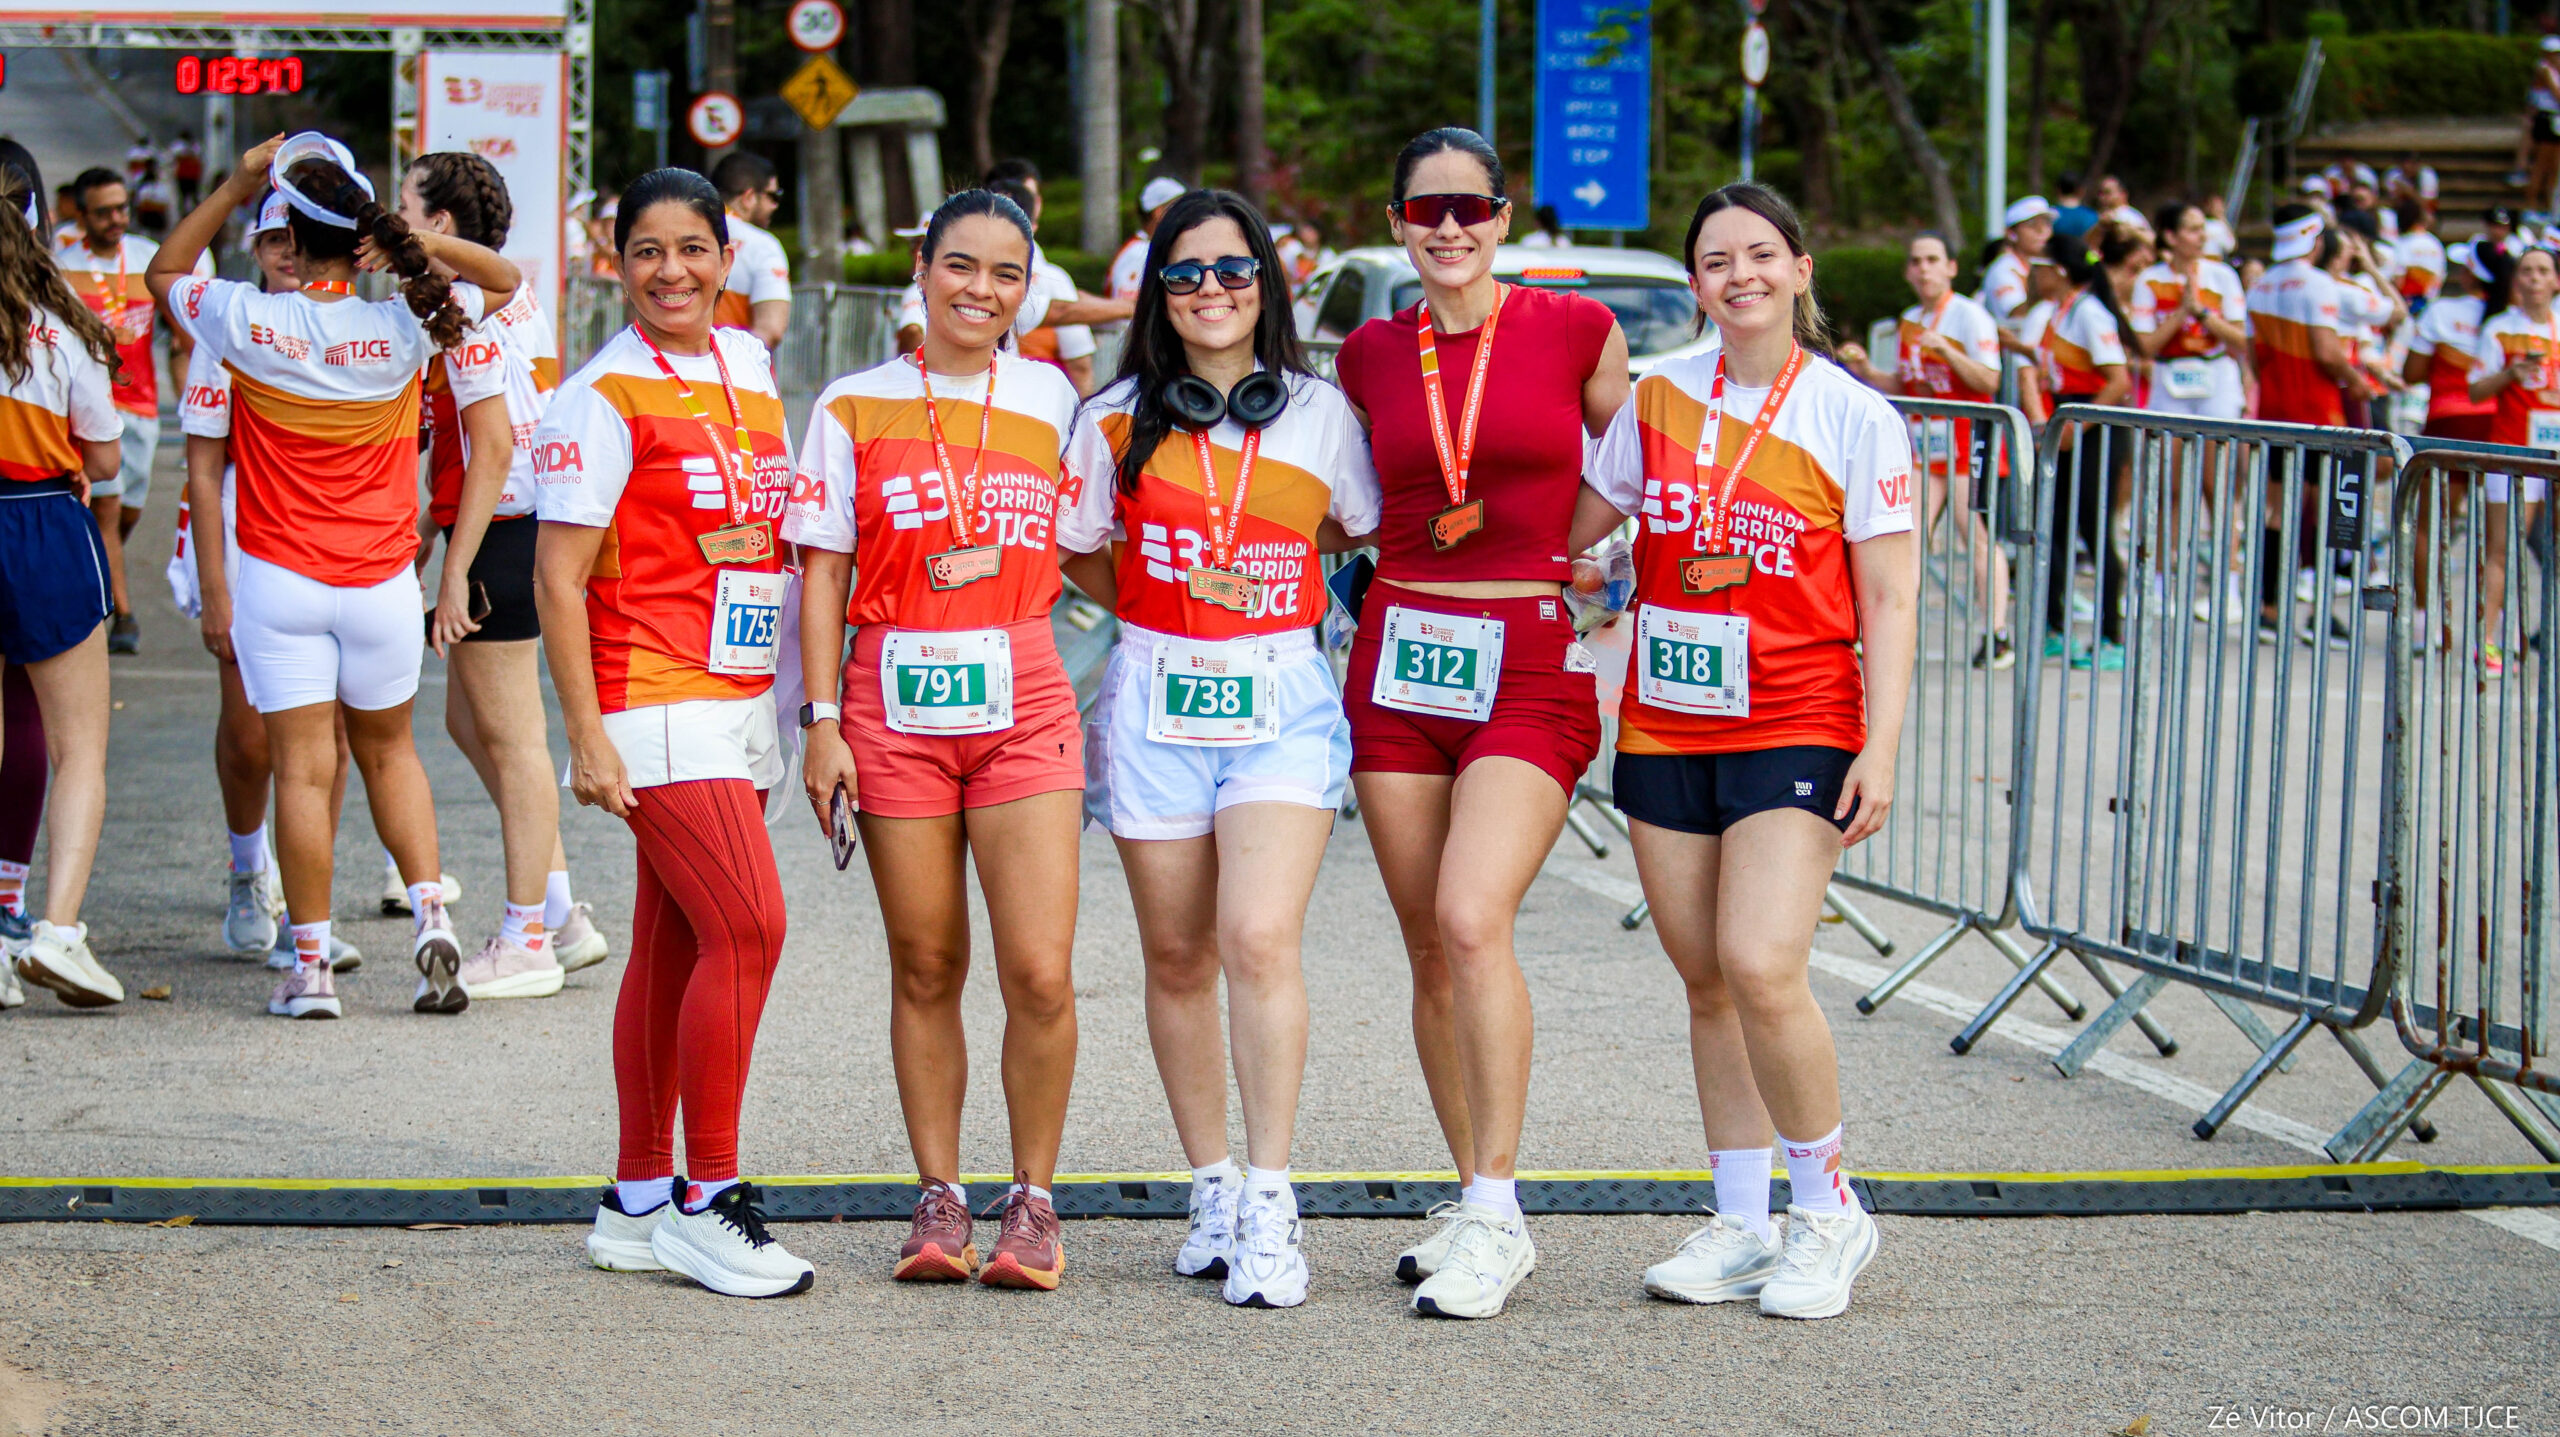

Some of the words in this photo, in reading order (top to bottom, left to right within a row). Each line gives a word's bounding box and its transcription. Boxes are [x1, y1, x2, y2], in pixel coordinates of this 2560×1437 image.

[800, 9, 836, 33] 30
[28, 324, 60, 346] JCE
[349, 340, 391, 359] TJCE
[448, 341, 503, 371] VIDA
[1462, 370, 1484, 451] CAMINHADA/CORRIDA
[1477, 358, 1487, 370] DO
[1769, 390, 1783, 408] 2026
[1430, 391, 1452, 473] CAMINHADA/CORRIDA
[1197, 432, 1215, 489] CAMINHADA/CO
[1719, 436, 1759, 510] CAMINHADA/CORRIDA
[767, 490, 789, 519] TJ
[789, 472, 826, 512] DA
[1877, 473, 1913, 508] VID
[995, 511, 1050, 551] TJCE
[721, 586, 729, 607] 5KM
[730, 606, 779, 645] 1753
[1388, 622, 1397, 643] 3KM
[1440, 635, 1454, 643] TJCE
[1686, 632, 1698, 640] TJCE
[886, 649, 895, 670] 3KM
[943, 654, 959, 662] TJCE
[1157, 657, 1165, 678] 3KM
[1407, 643, 1465, 686] 312
[1658, 641, 1711, 683] 318
[908, 667, 970, 704] 791
[1178, 677, 1241, 715] 738
